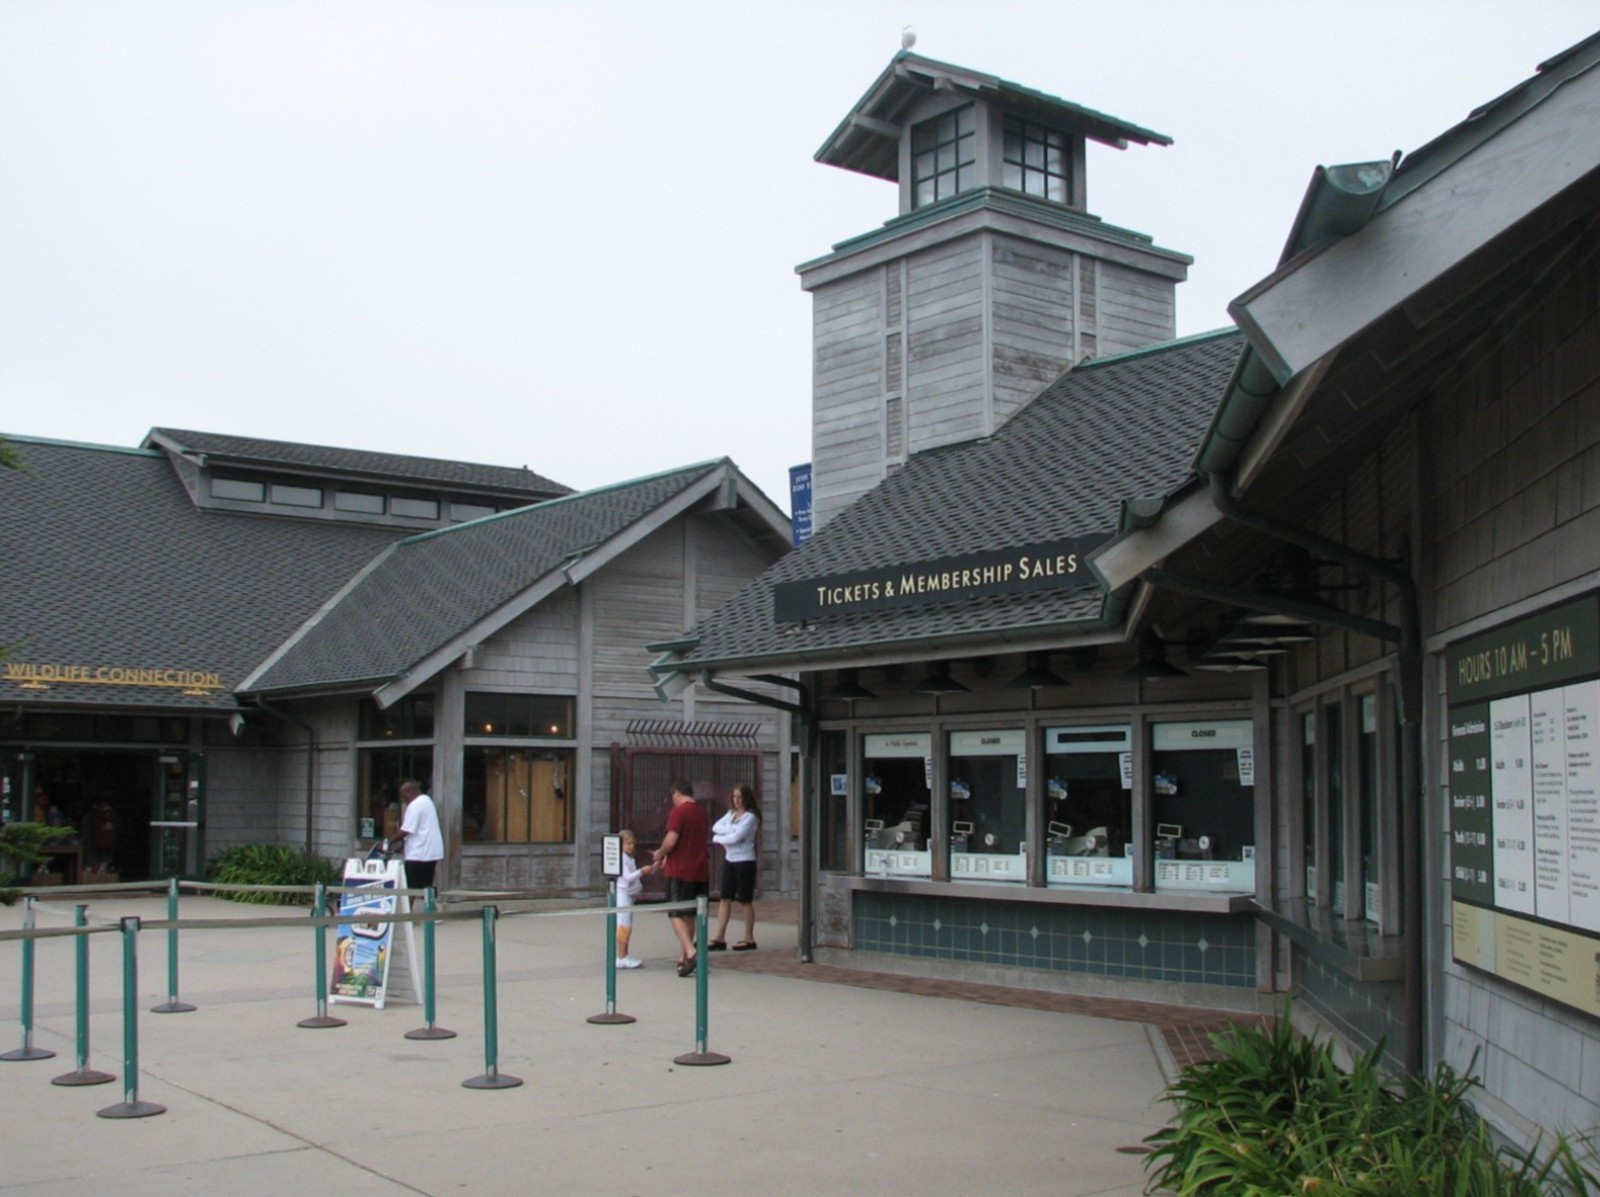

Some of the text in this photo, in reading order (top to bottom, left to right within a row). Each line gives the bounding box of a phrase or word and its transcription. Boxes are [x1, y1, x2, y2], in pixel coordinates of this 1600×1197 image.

[884, 580, 895, 597] &
[1458, 651, 1491, 686] HOURS
[1495, 646, 1507, 677] 10
[1510, 641, 1528, 673] AM
[1541, 632, 1548, 665] 5
[1553, 626, 1573, 662] PM
[8, 663, 220, 685] WILDLIFE CONNECTION
